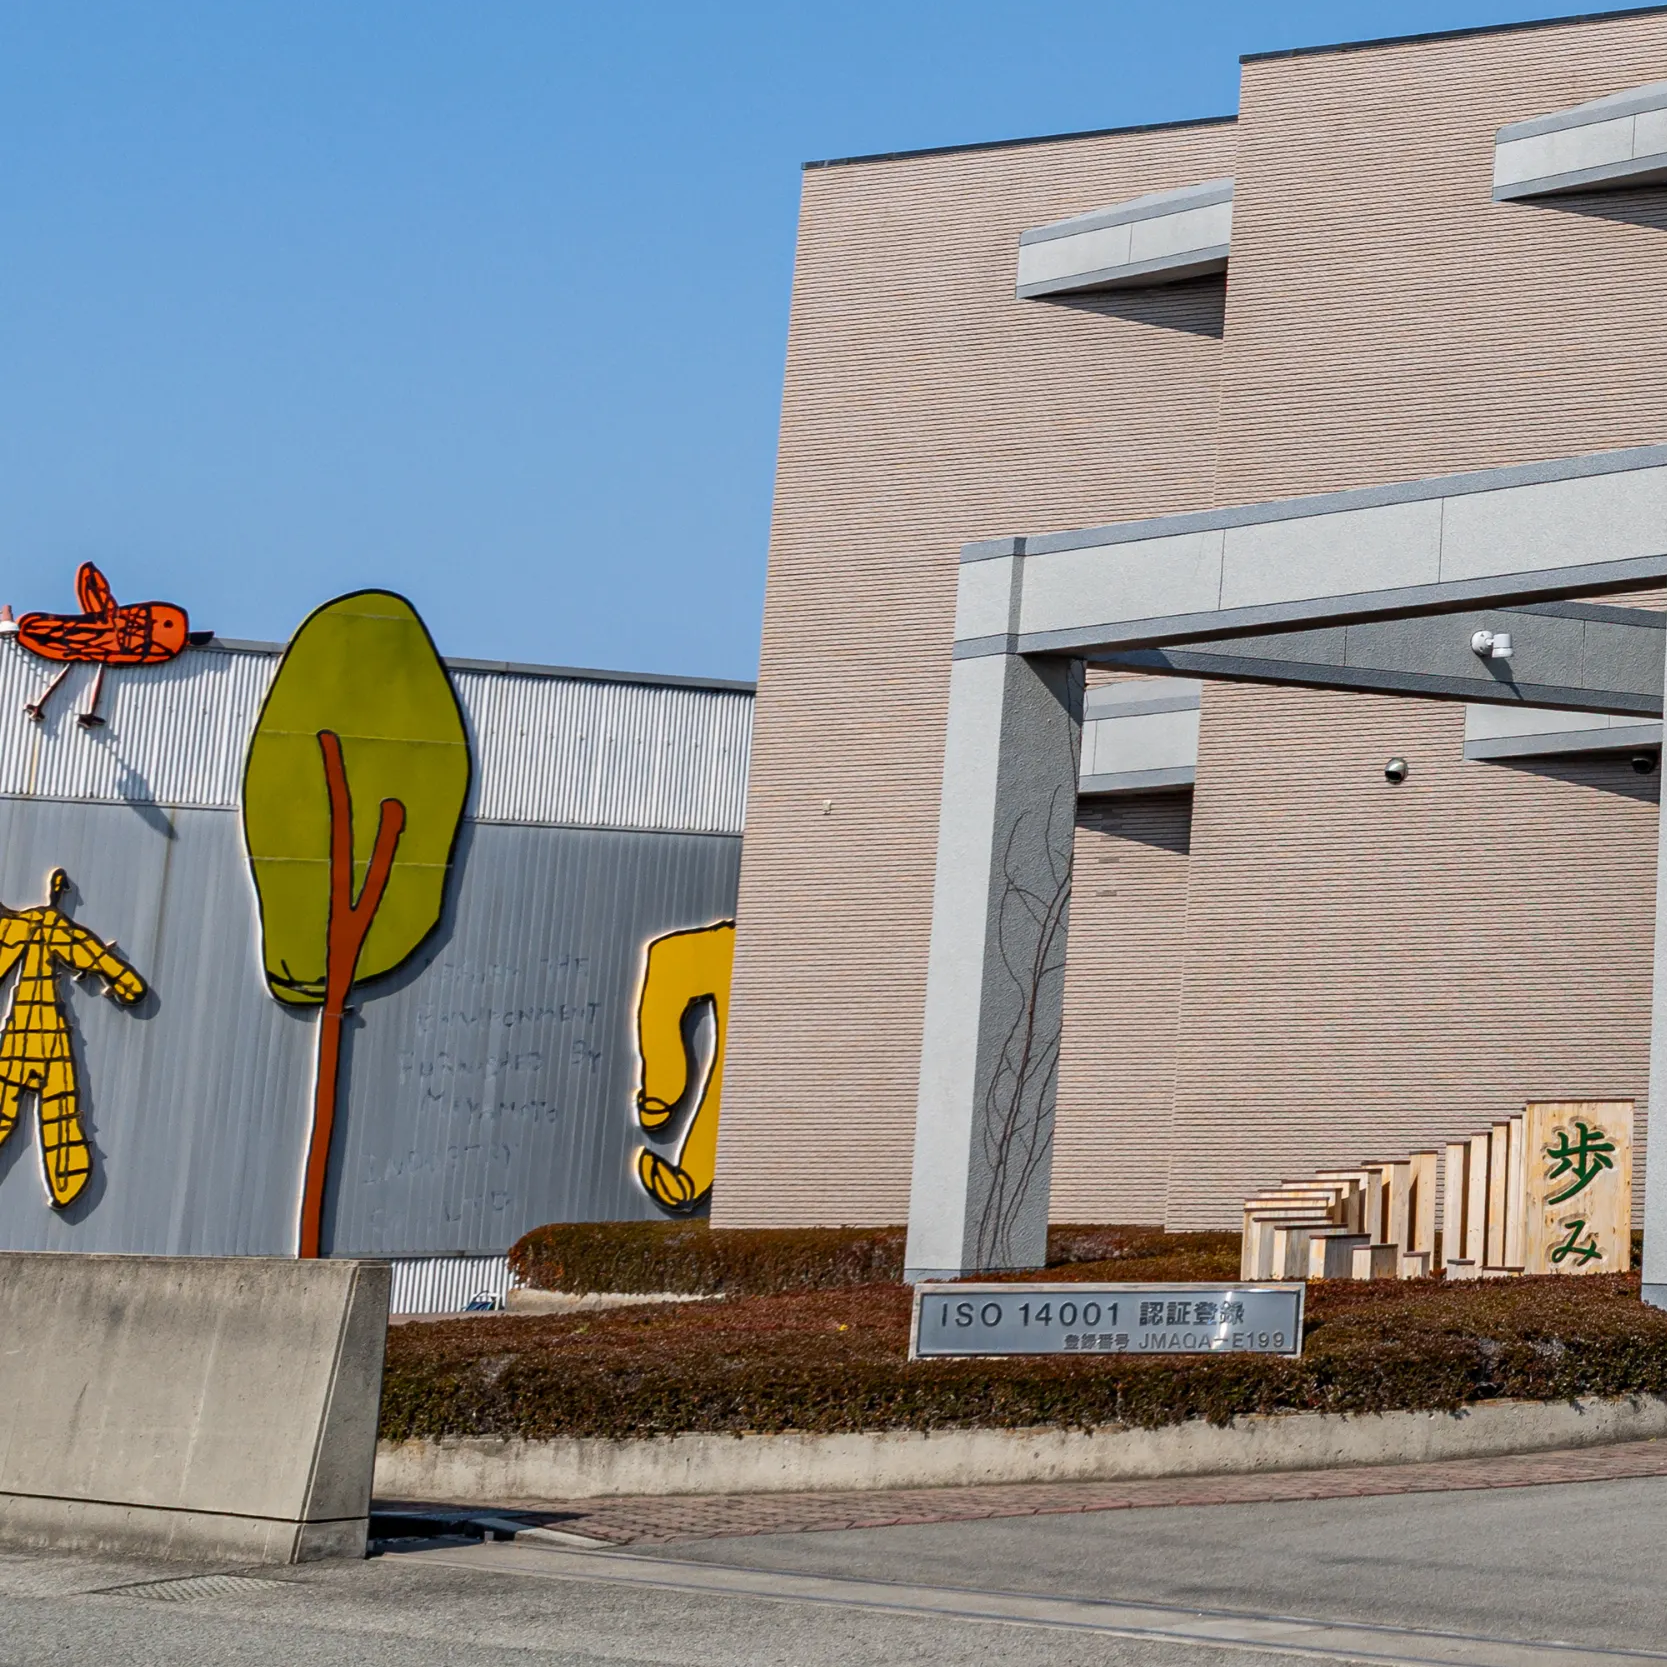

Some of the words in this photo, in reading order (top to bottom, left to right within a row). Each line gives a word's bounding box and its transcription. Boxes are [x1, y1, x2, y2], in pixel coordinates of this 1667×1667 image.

[1546, 1121, 1616, 1267] 歩み
[940, 1301, 1003, 1327] ISO
[1018, 1301, 1119, 1327] 14001
[1138, 1300, 1245, 1327] 認証登録
